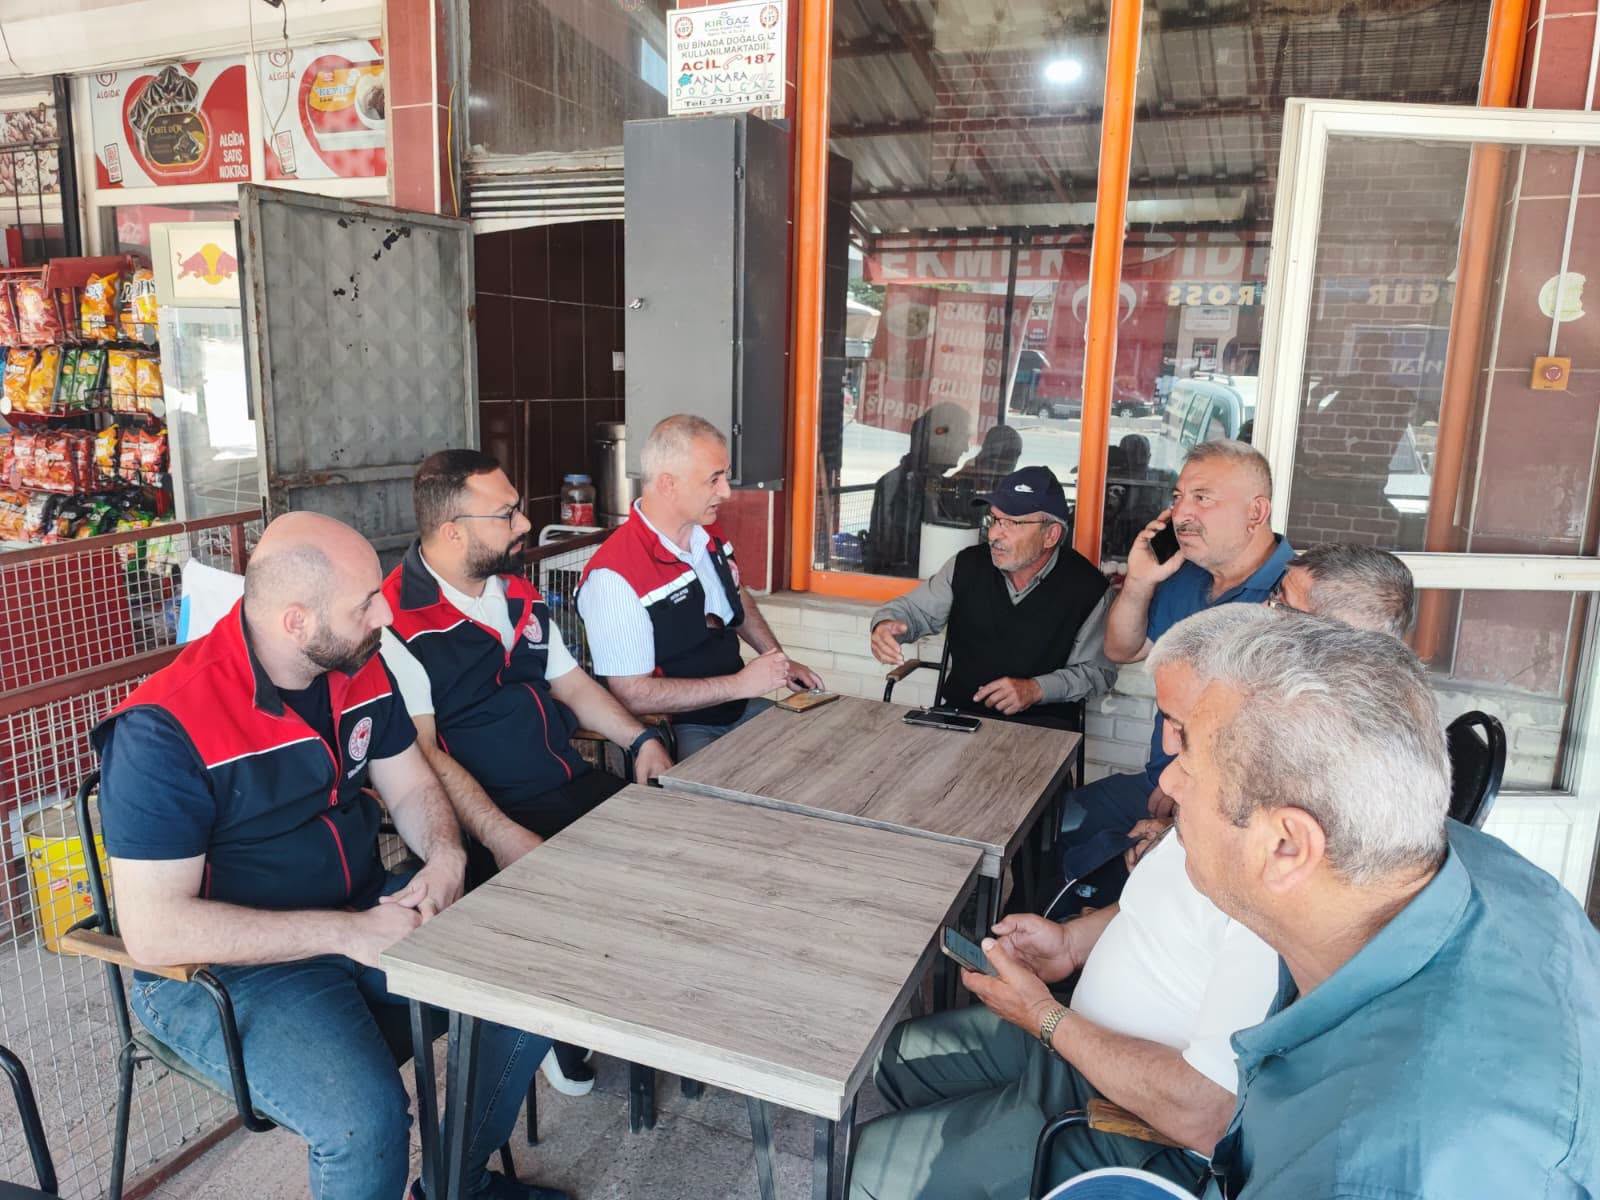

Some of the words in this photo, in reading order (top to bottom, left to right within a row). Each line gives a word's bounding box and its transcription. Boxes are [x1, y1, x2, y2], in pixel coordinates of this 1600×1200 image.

[678, 41, 690, 51] BU
[680, 57, 721, 72] ACİL
[744, 53, 776, 65] 187
[693, 71, 748, 86] ANKARA
